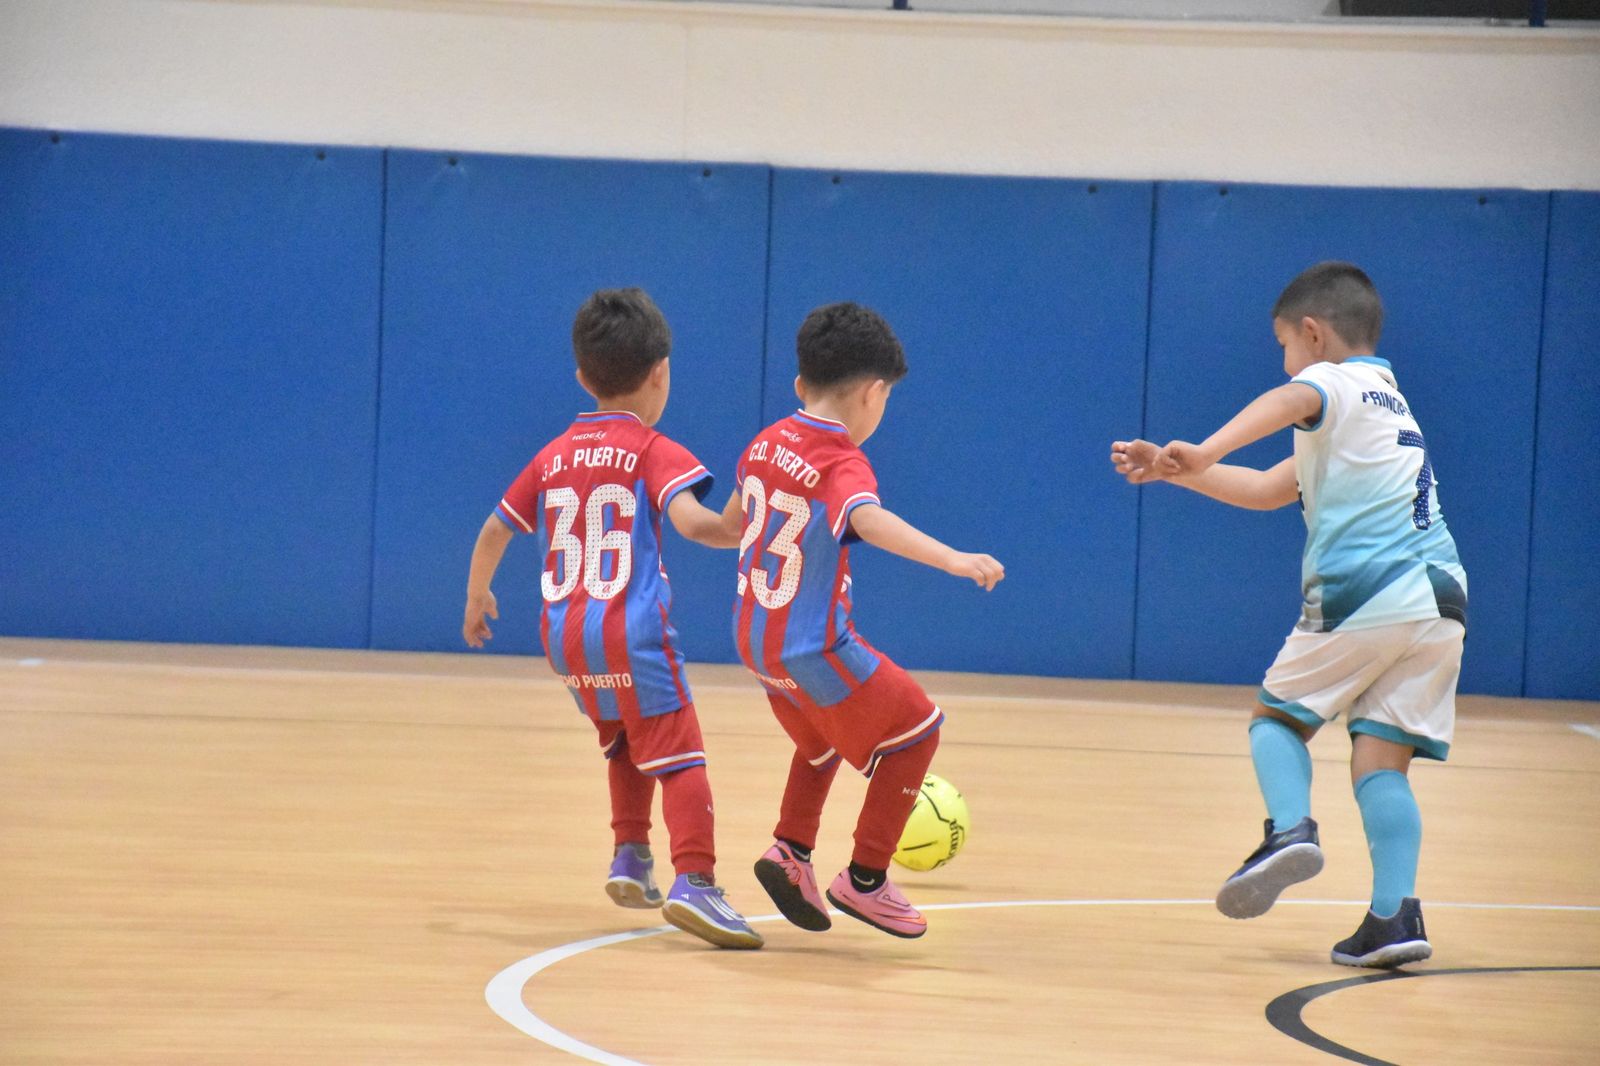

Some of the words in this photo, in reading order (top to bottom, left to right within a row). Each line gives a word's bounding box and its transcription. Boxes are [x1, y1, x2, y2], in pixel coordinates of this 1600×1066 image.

[573, 446, 638, 473] PUERTO
[770, 444, 821, 489] PUERTO
[1397, 429, 1432, 531] 7
[541, 483, 637, 602] 36
[737, 474, 811, 610] 23
[581, 672, 633, 689] PUERTO
